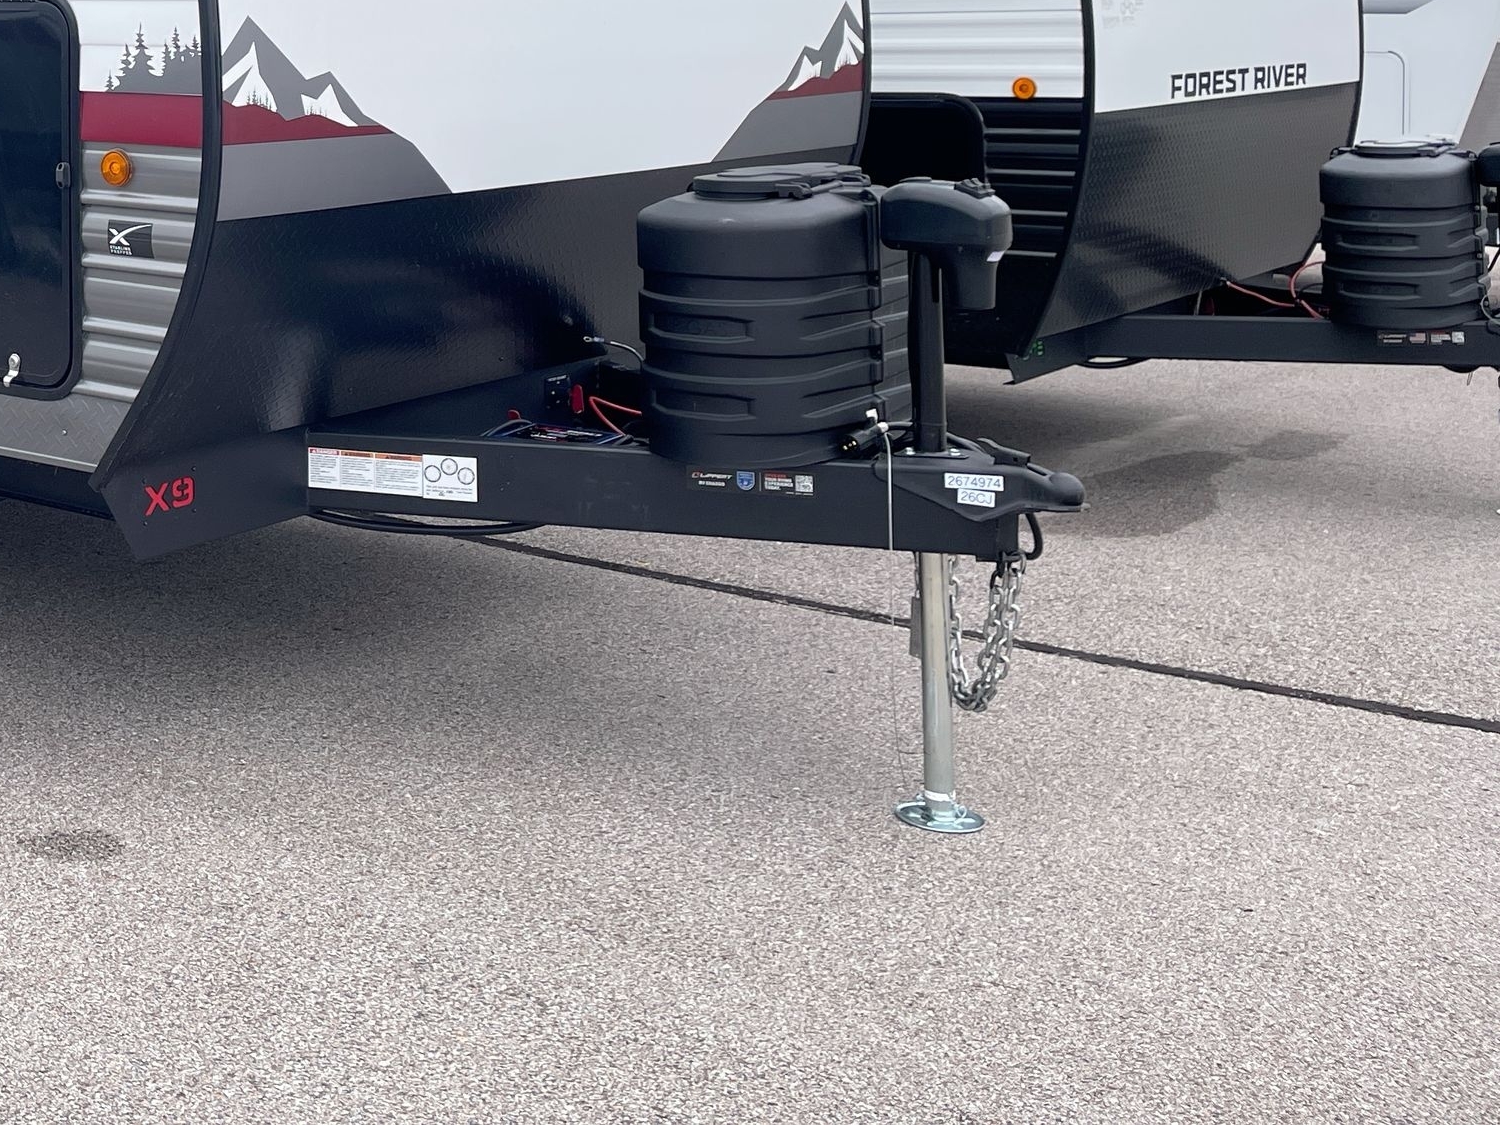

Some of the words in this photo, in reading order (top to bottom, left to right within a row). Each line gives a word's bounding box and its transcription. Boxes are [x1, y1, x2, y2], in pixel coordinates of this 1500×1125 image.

[1171, 67, 1250, 100] FOREST
[1253, 62, 1307, 91] RIVER
[947, 475, 1001, 488] 2674974
[144, 477, 194, 516] X9
[960, 491, 993, 505] 26CJ
